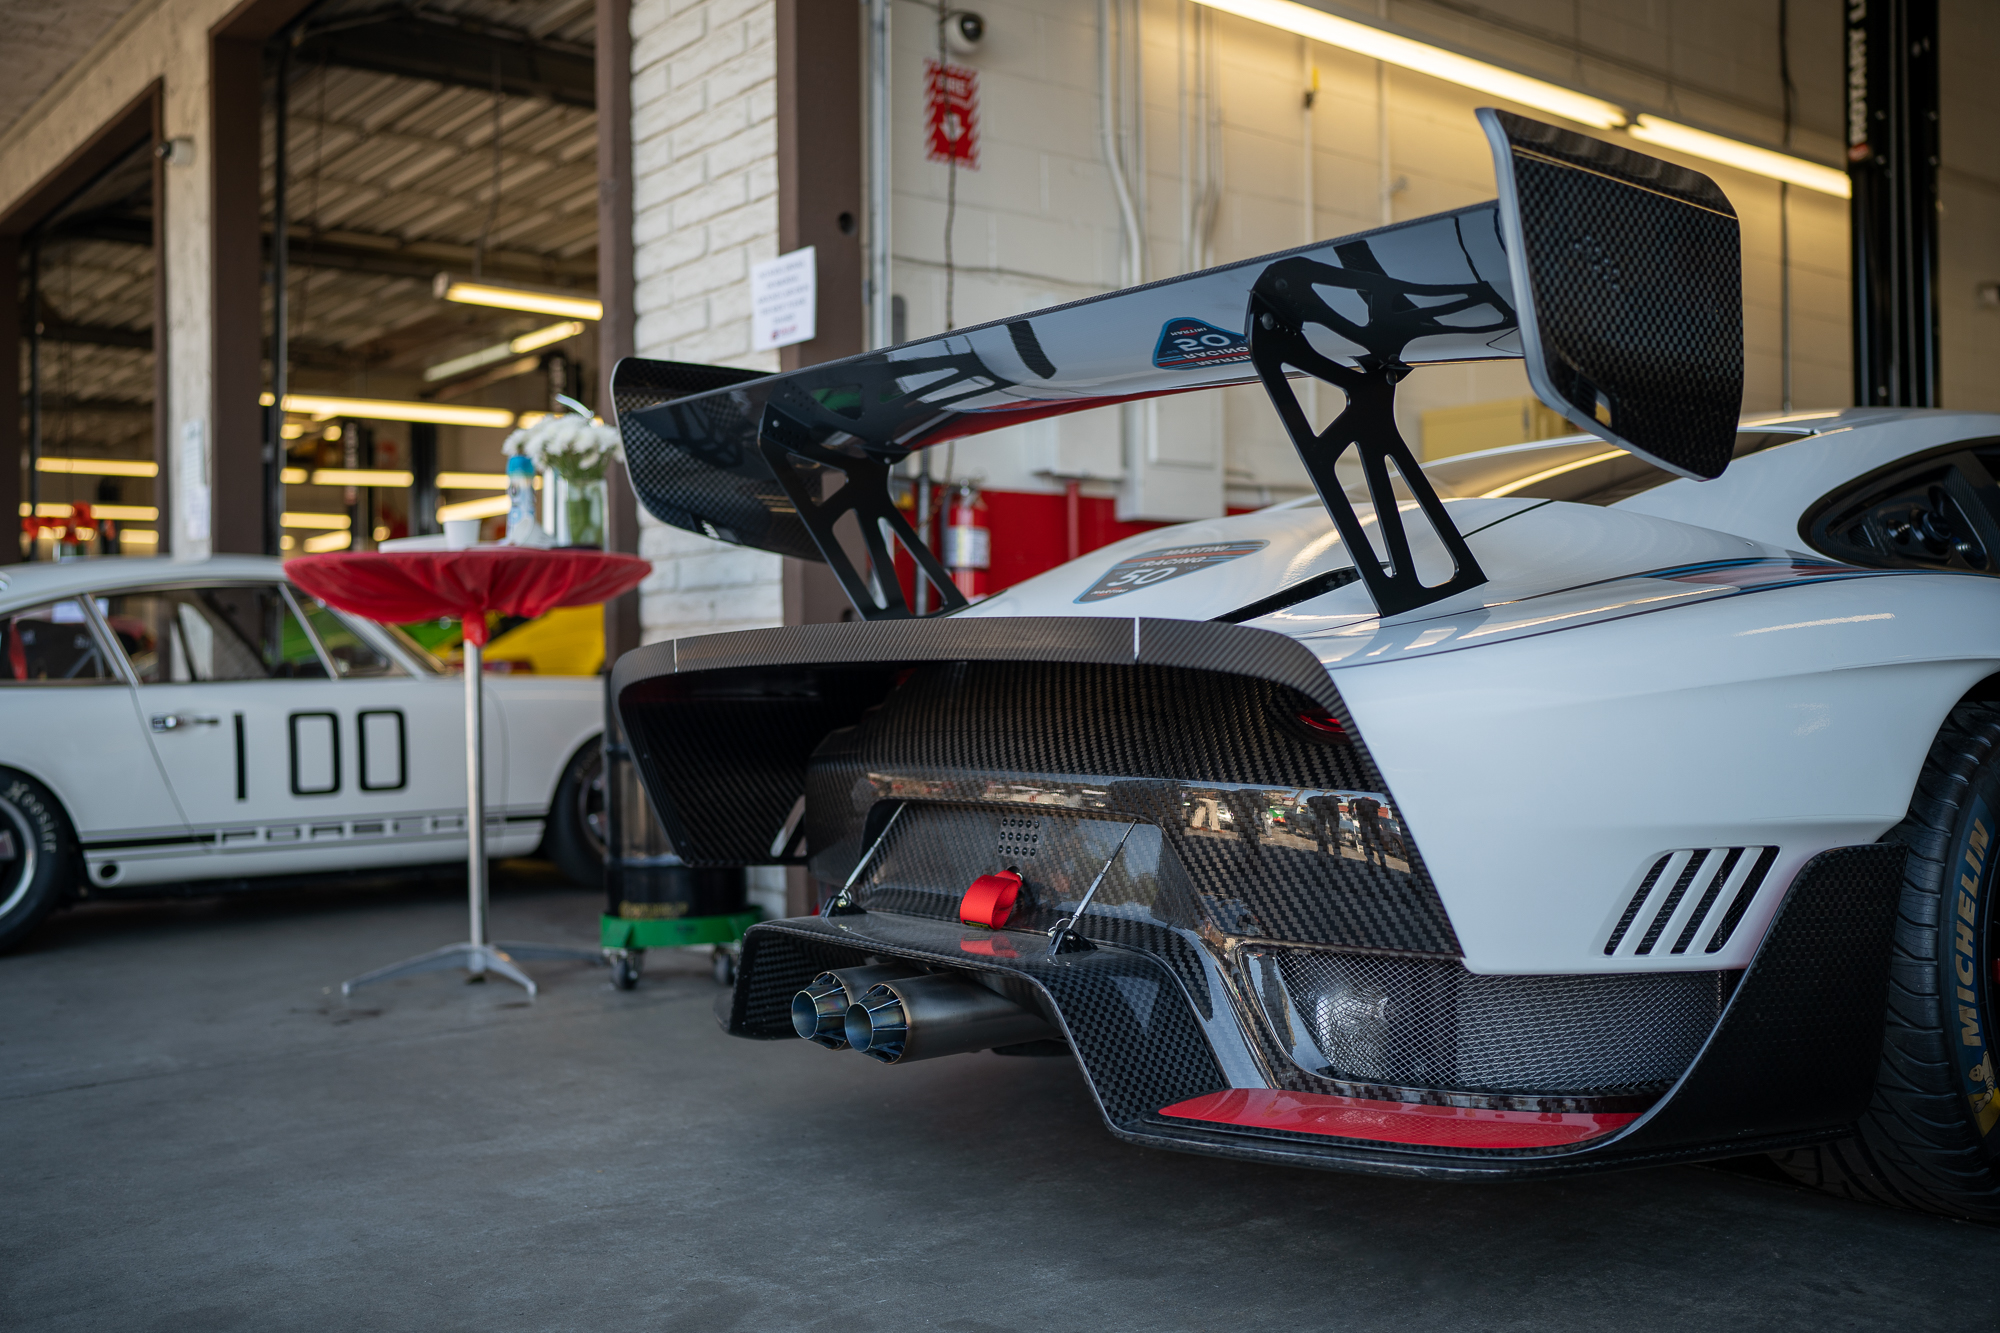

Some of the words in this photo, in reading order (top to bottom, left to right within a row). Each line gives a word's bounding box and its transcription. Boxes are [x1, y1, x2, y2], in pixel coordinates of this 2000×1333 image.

[935, 77, 967, 97] FRE
[1848, 28, 1867, 145] ROTARY
[1162, 545, 1231, 556] MARTINI
[1139, 556, 1207, 568] RACING
[1106, 567, 1178, 587] 50
[1090, 588, 1129, 596] MARTINI
[234, 708, 408, 802] 100
[1955, 817, 1990, 1047] MICHELIN
